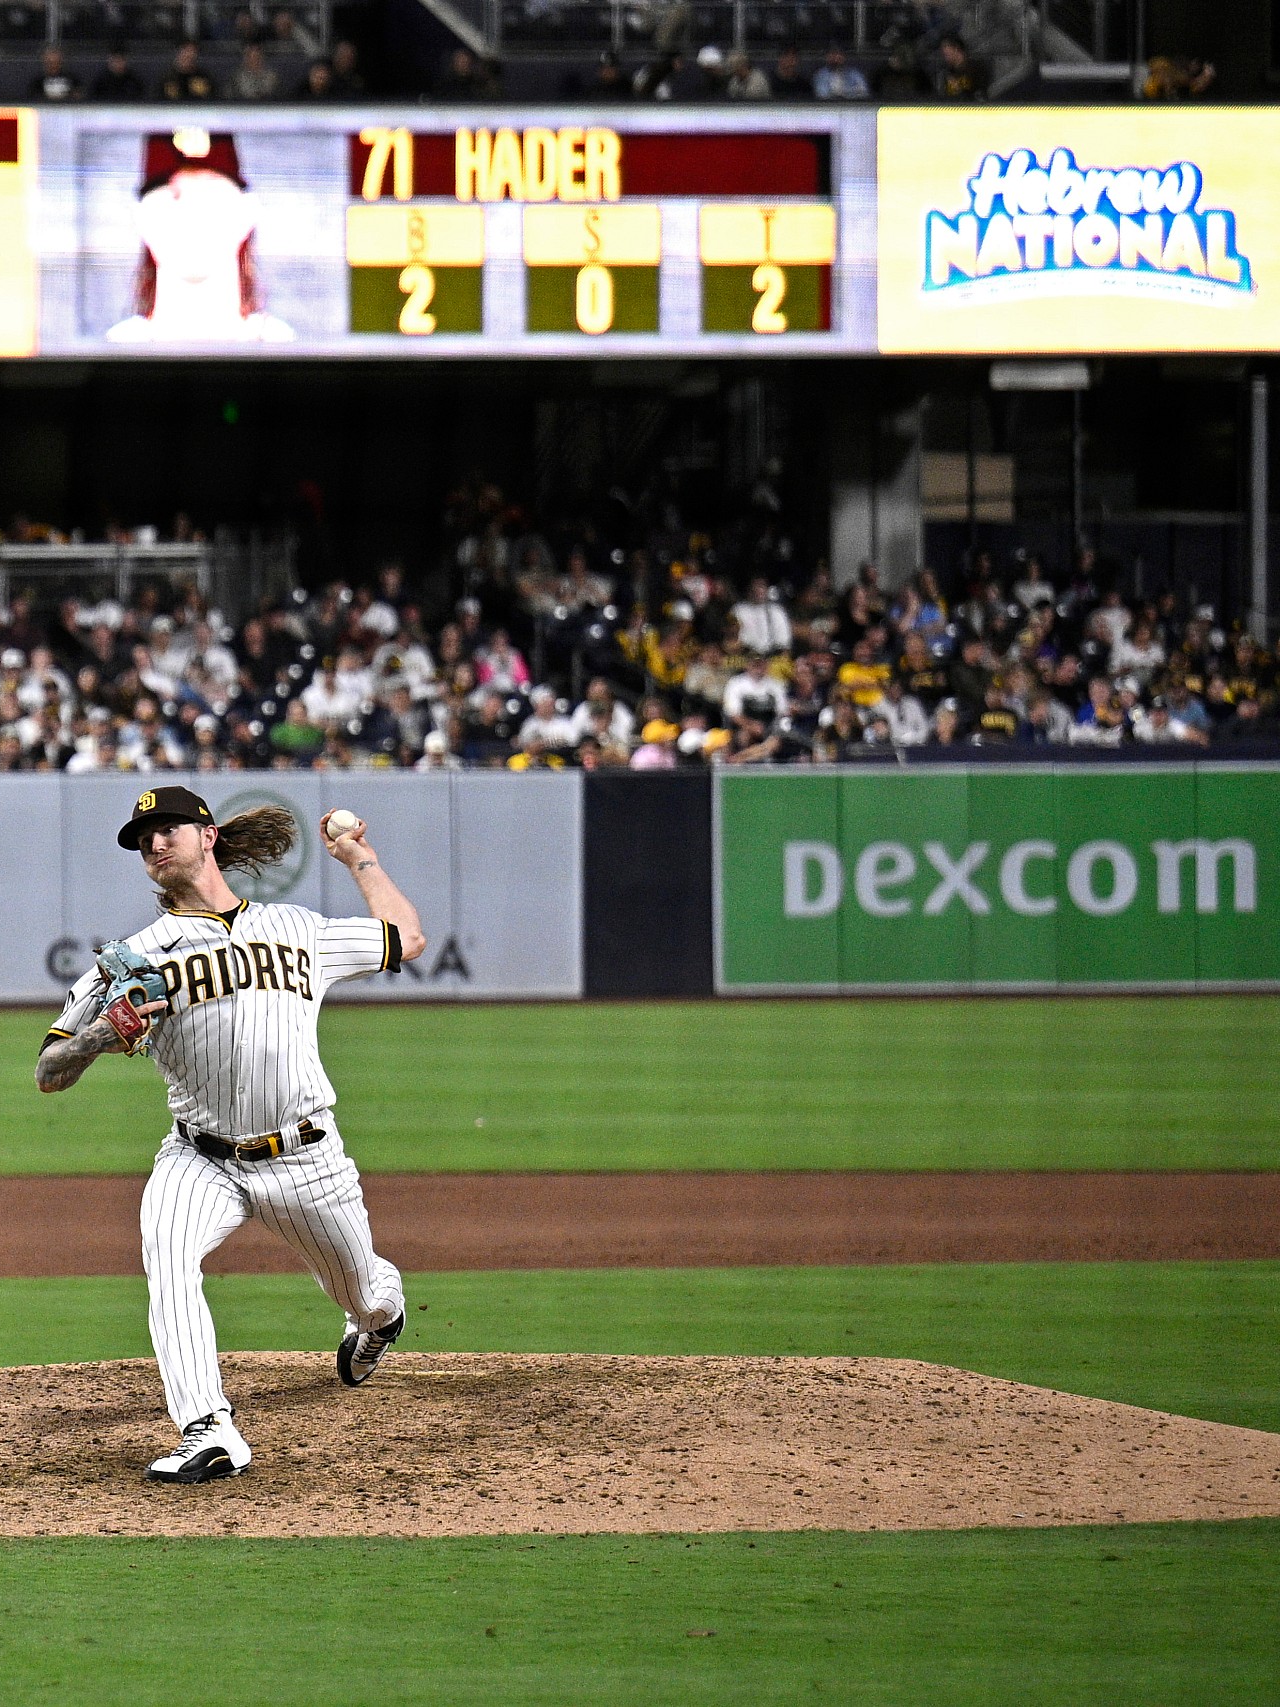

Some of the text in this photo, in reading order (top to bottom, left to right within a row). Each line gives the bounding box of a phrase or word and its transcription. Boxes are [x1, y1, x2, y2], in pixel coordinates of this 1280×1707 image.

[360, 127, 621, 201] 71 HADER
[968, 146, 1202, 217] Hebrew
[584, 209, 600, 259] S
[759, 208, 776, 259] T
[925, 209, 1253, 289] NATIONAL
[398, 264, 788, 336] 2 0 2
[158, 941, 314, 1018] PADRES
